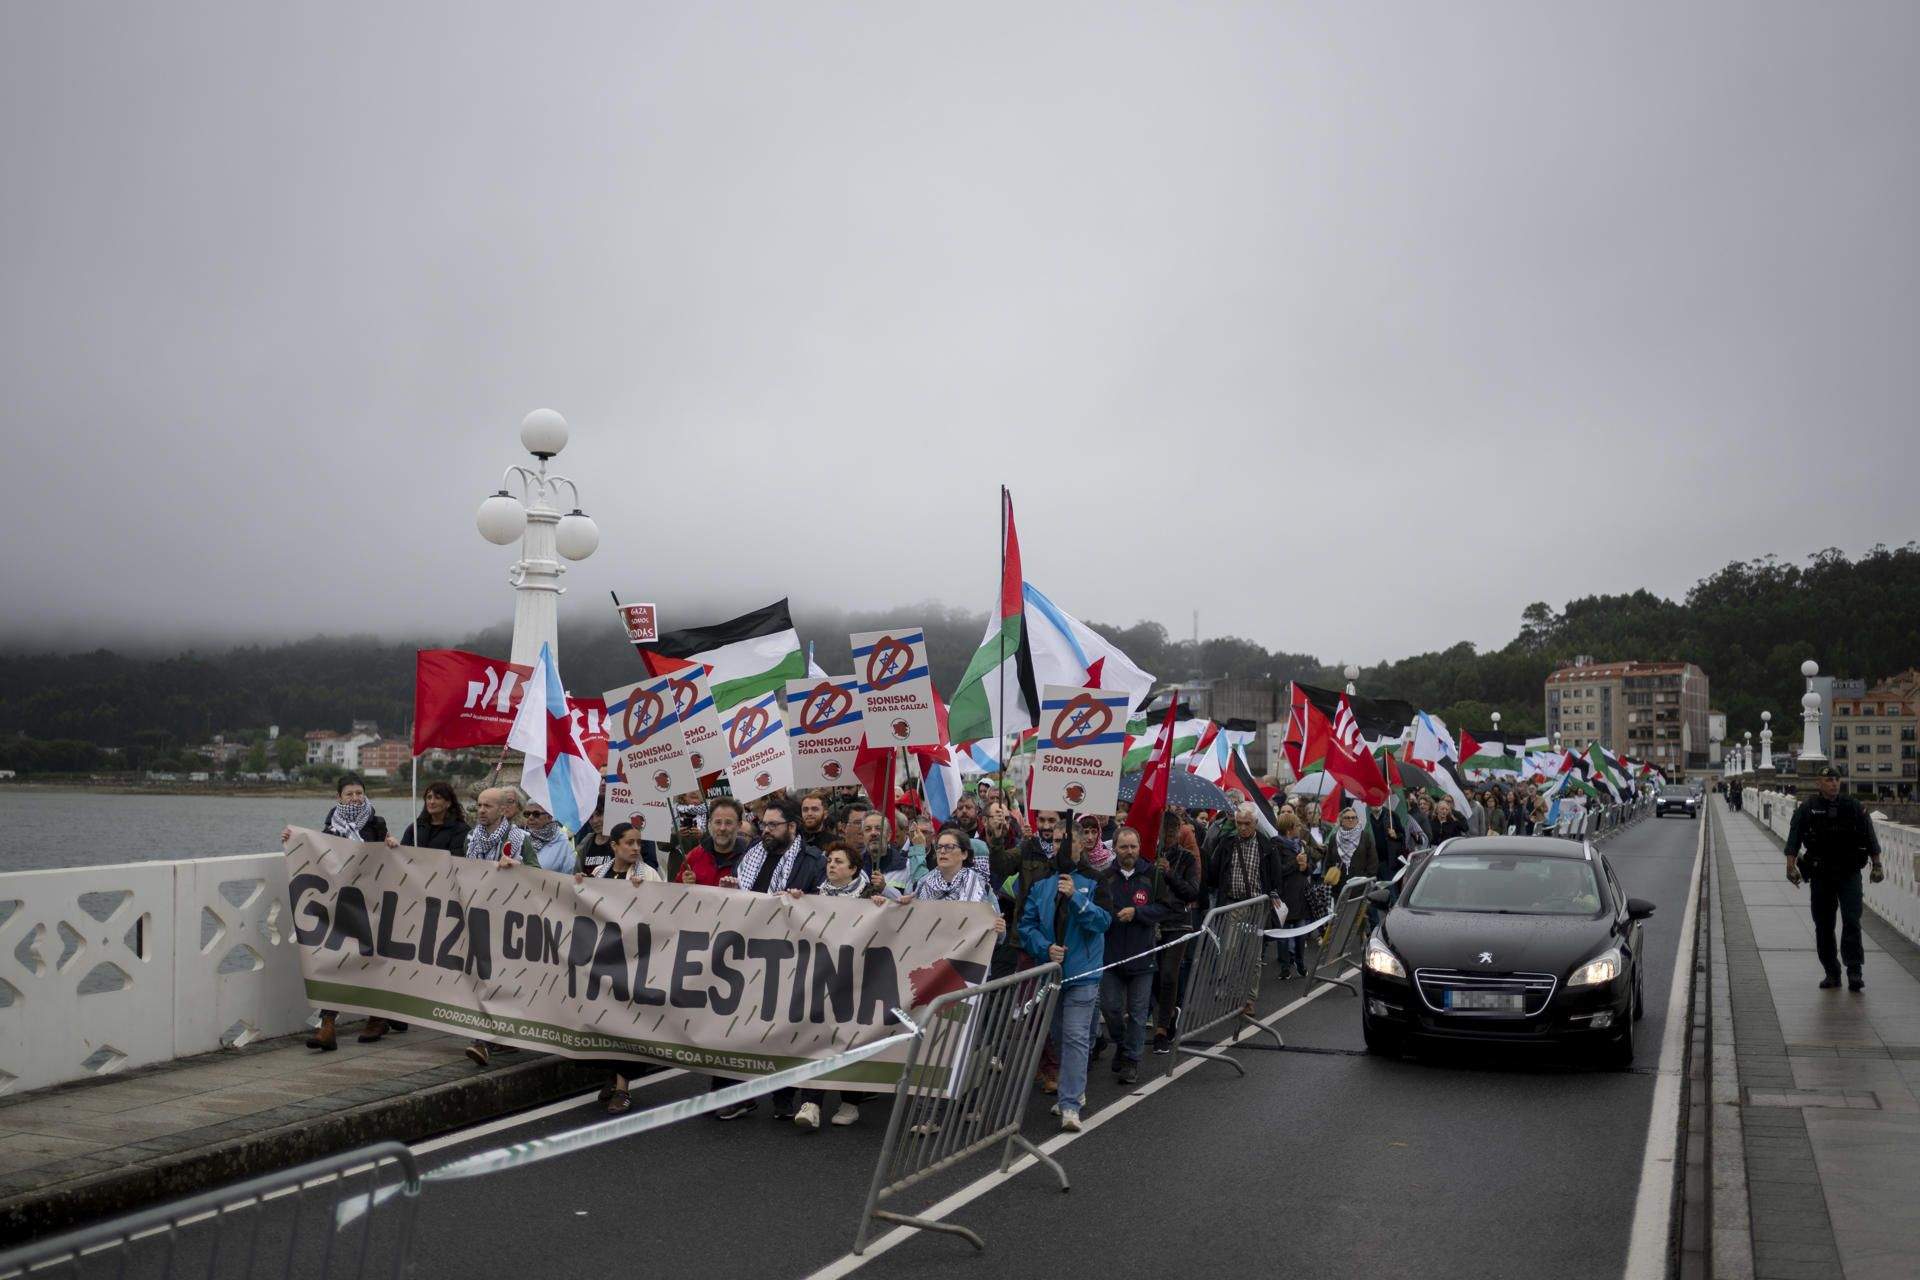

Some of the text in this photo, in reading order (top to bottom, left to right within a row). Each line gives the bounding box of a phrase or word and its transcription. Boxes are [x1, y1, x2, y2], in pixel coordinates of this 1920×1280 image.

[866, 694, 917, 706] SIONISMO
[868, 704, 888, 712] FÓRA
[900, 703, 929, 711] GALIZA!
[691, 730, 718, 744] GALIZA!
[798, 736, 852, 748] SIONISMO
[627, 743, 673, 762] SIONISMO
[762, 750, 786, 764] GALIZA!
[798, 747, 820, 755] FÓRA
[629, 760, 648, 769] FÓRA
[659, 750, 684, 762] GALIZA!
[731, 747, 775, 771] SIONISMO
[1043, 754, 1103, 768] SIONISMO
[1081, 768, 1114, 777] GALIZA!
[707, 786, 722, 798] NOM
[288, 873, 902, 1027] GALIZA CON PALESTINA
[432, 1007, 777, 1072] COORDENADORA GALEGA DE SOLIDARIEDADE COA PALESTINA
